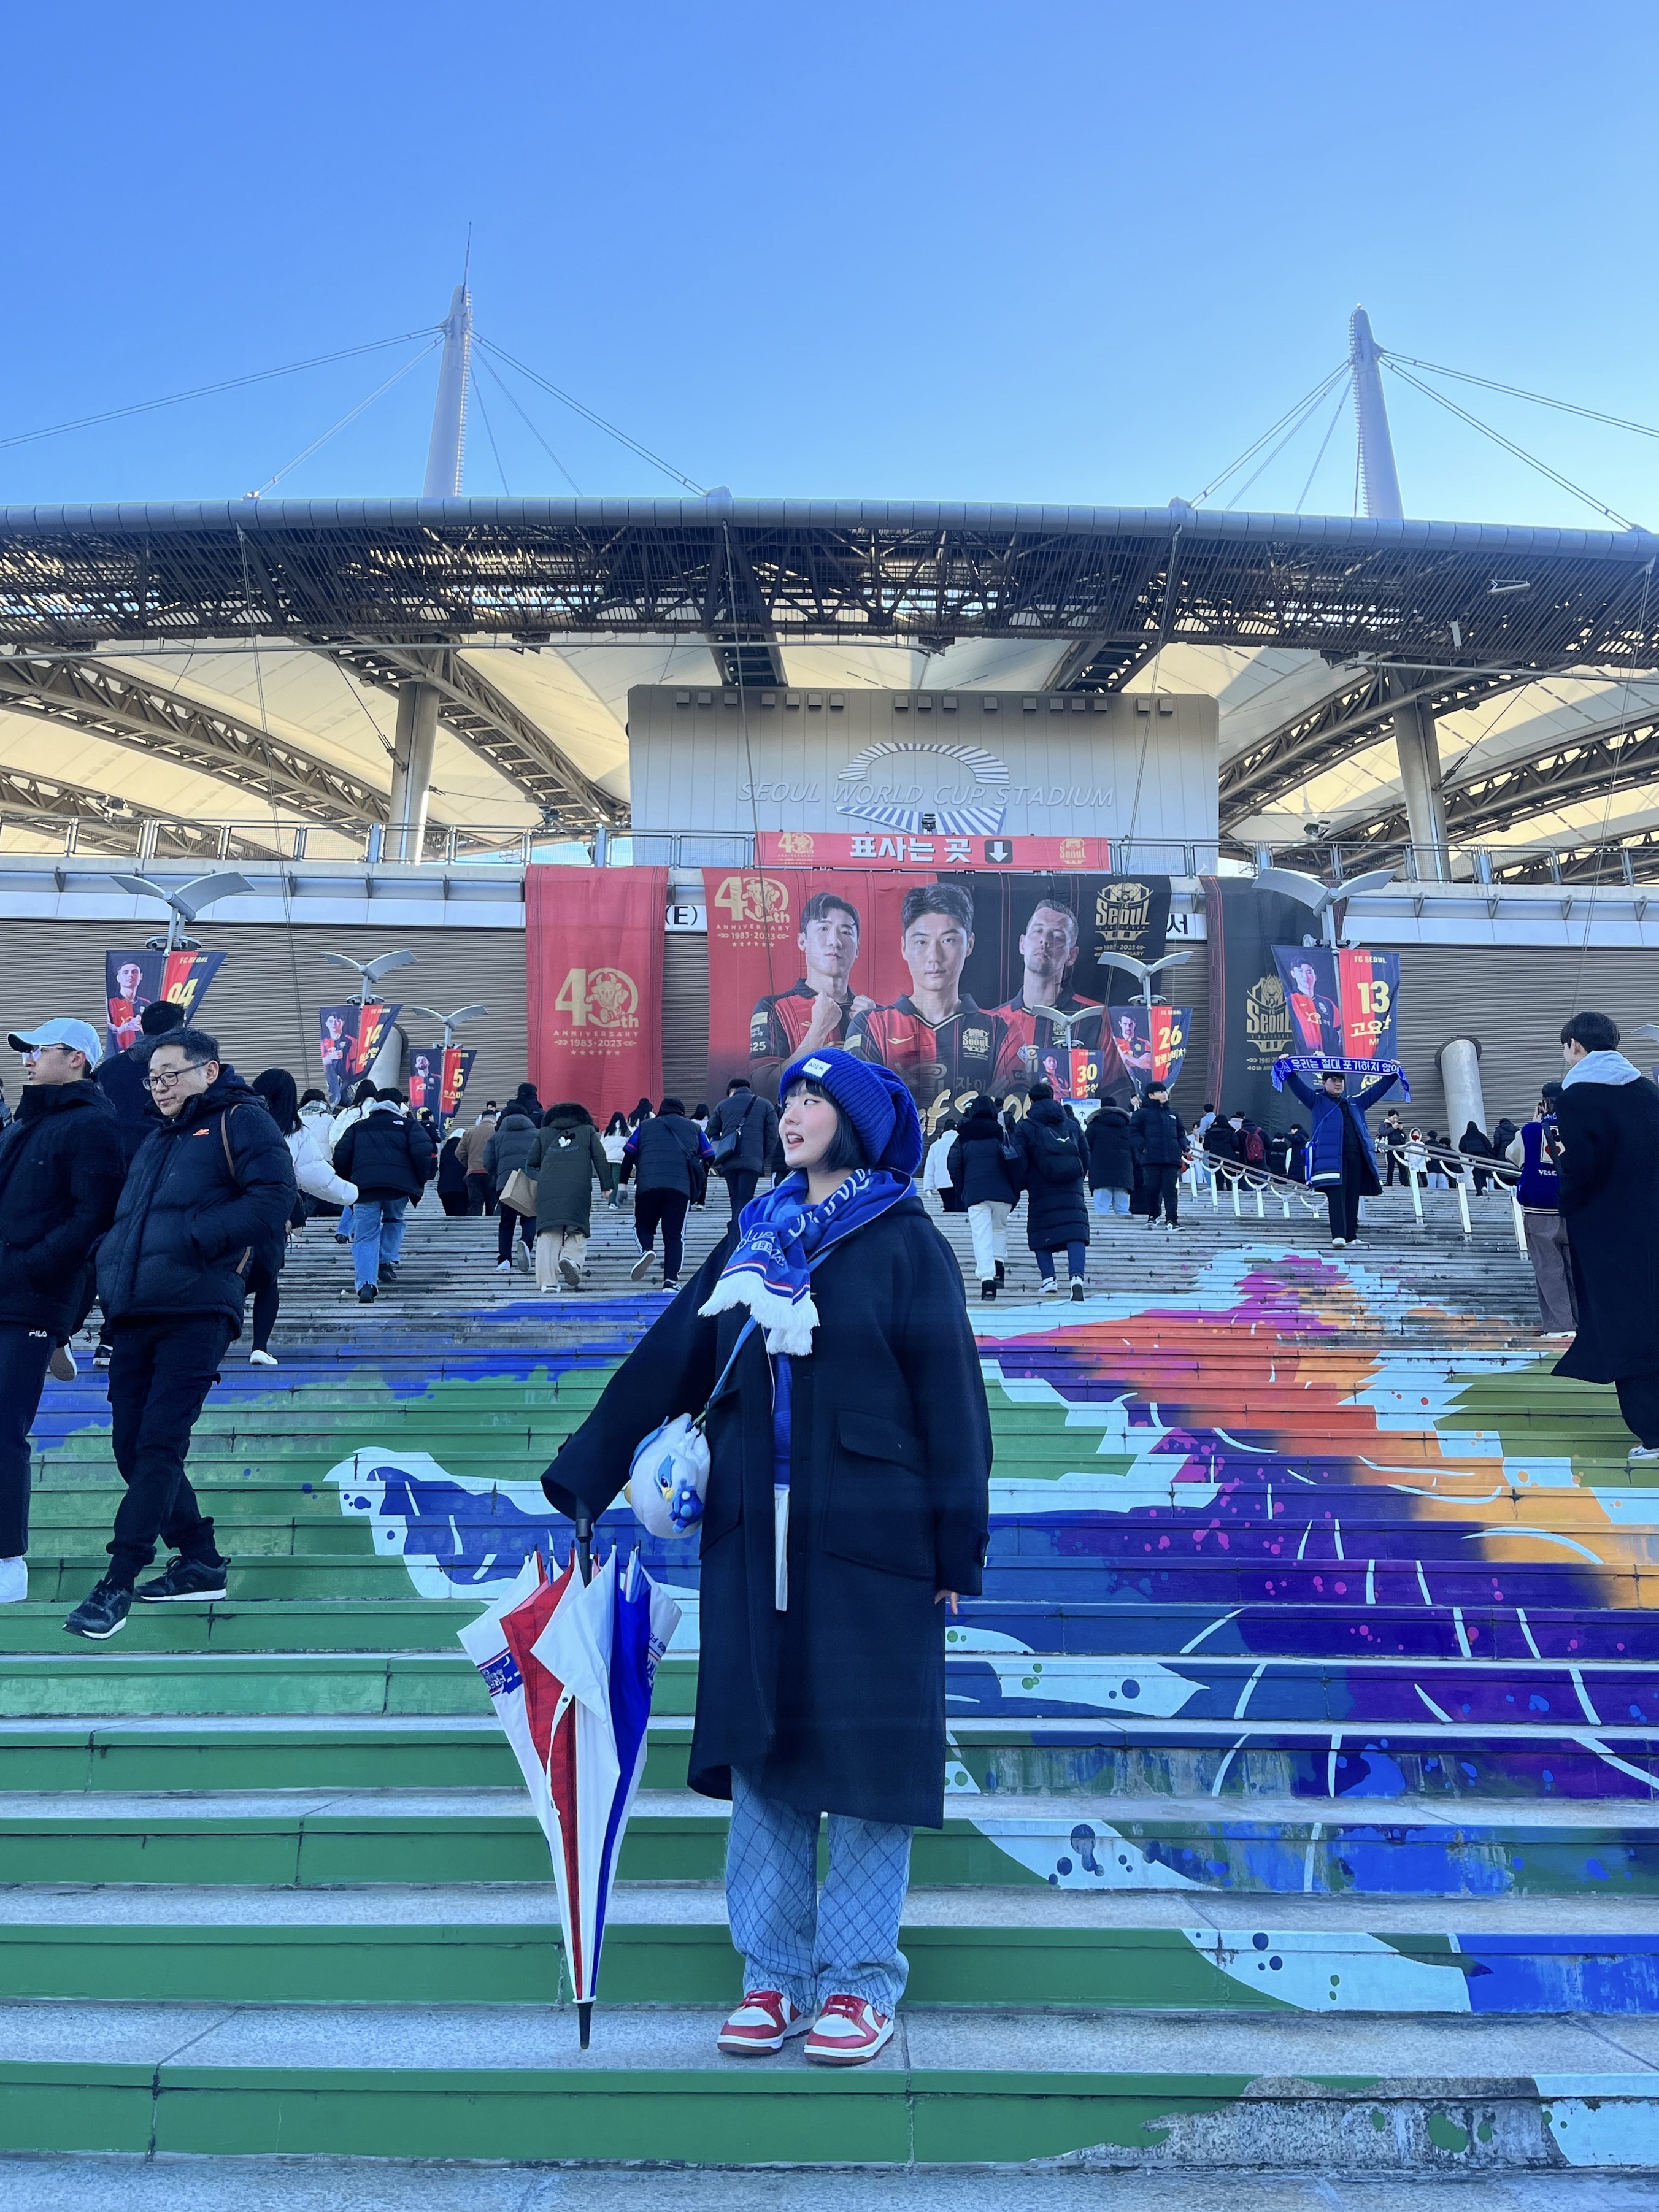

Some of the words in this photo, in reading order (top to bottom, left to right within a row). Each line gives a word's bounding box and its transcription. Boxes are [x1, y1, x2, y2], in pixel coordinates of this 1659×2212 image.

[737, 782, 820, 802] SEOUL
[832, 783, 923, 804] WORLD
[933, 785, 986, 805] CUP
[993, 786, 1114, 807] STADIUM
[944, 838, 971, 863] 곳
[665, 905, 698, 926] (E)
[1357, 981, 1390, 1015] 13
[364, 1024, 384, 1048] 14
[1158, 1024, 1182, 1051] 26
[1077, 1063, 1098, 1083] 30
[1291, 1059, 1319, 1070] 우리는
[1321, 1058, 1341, 1070] 절대
[1342, 1059, 1379, 1072] 포기하지
[452, 1068, 464, 1088] 5
